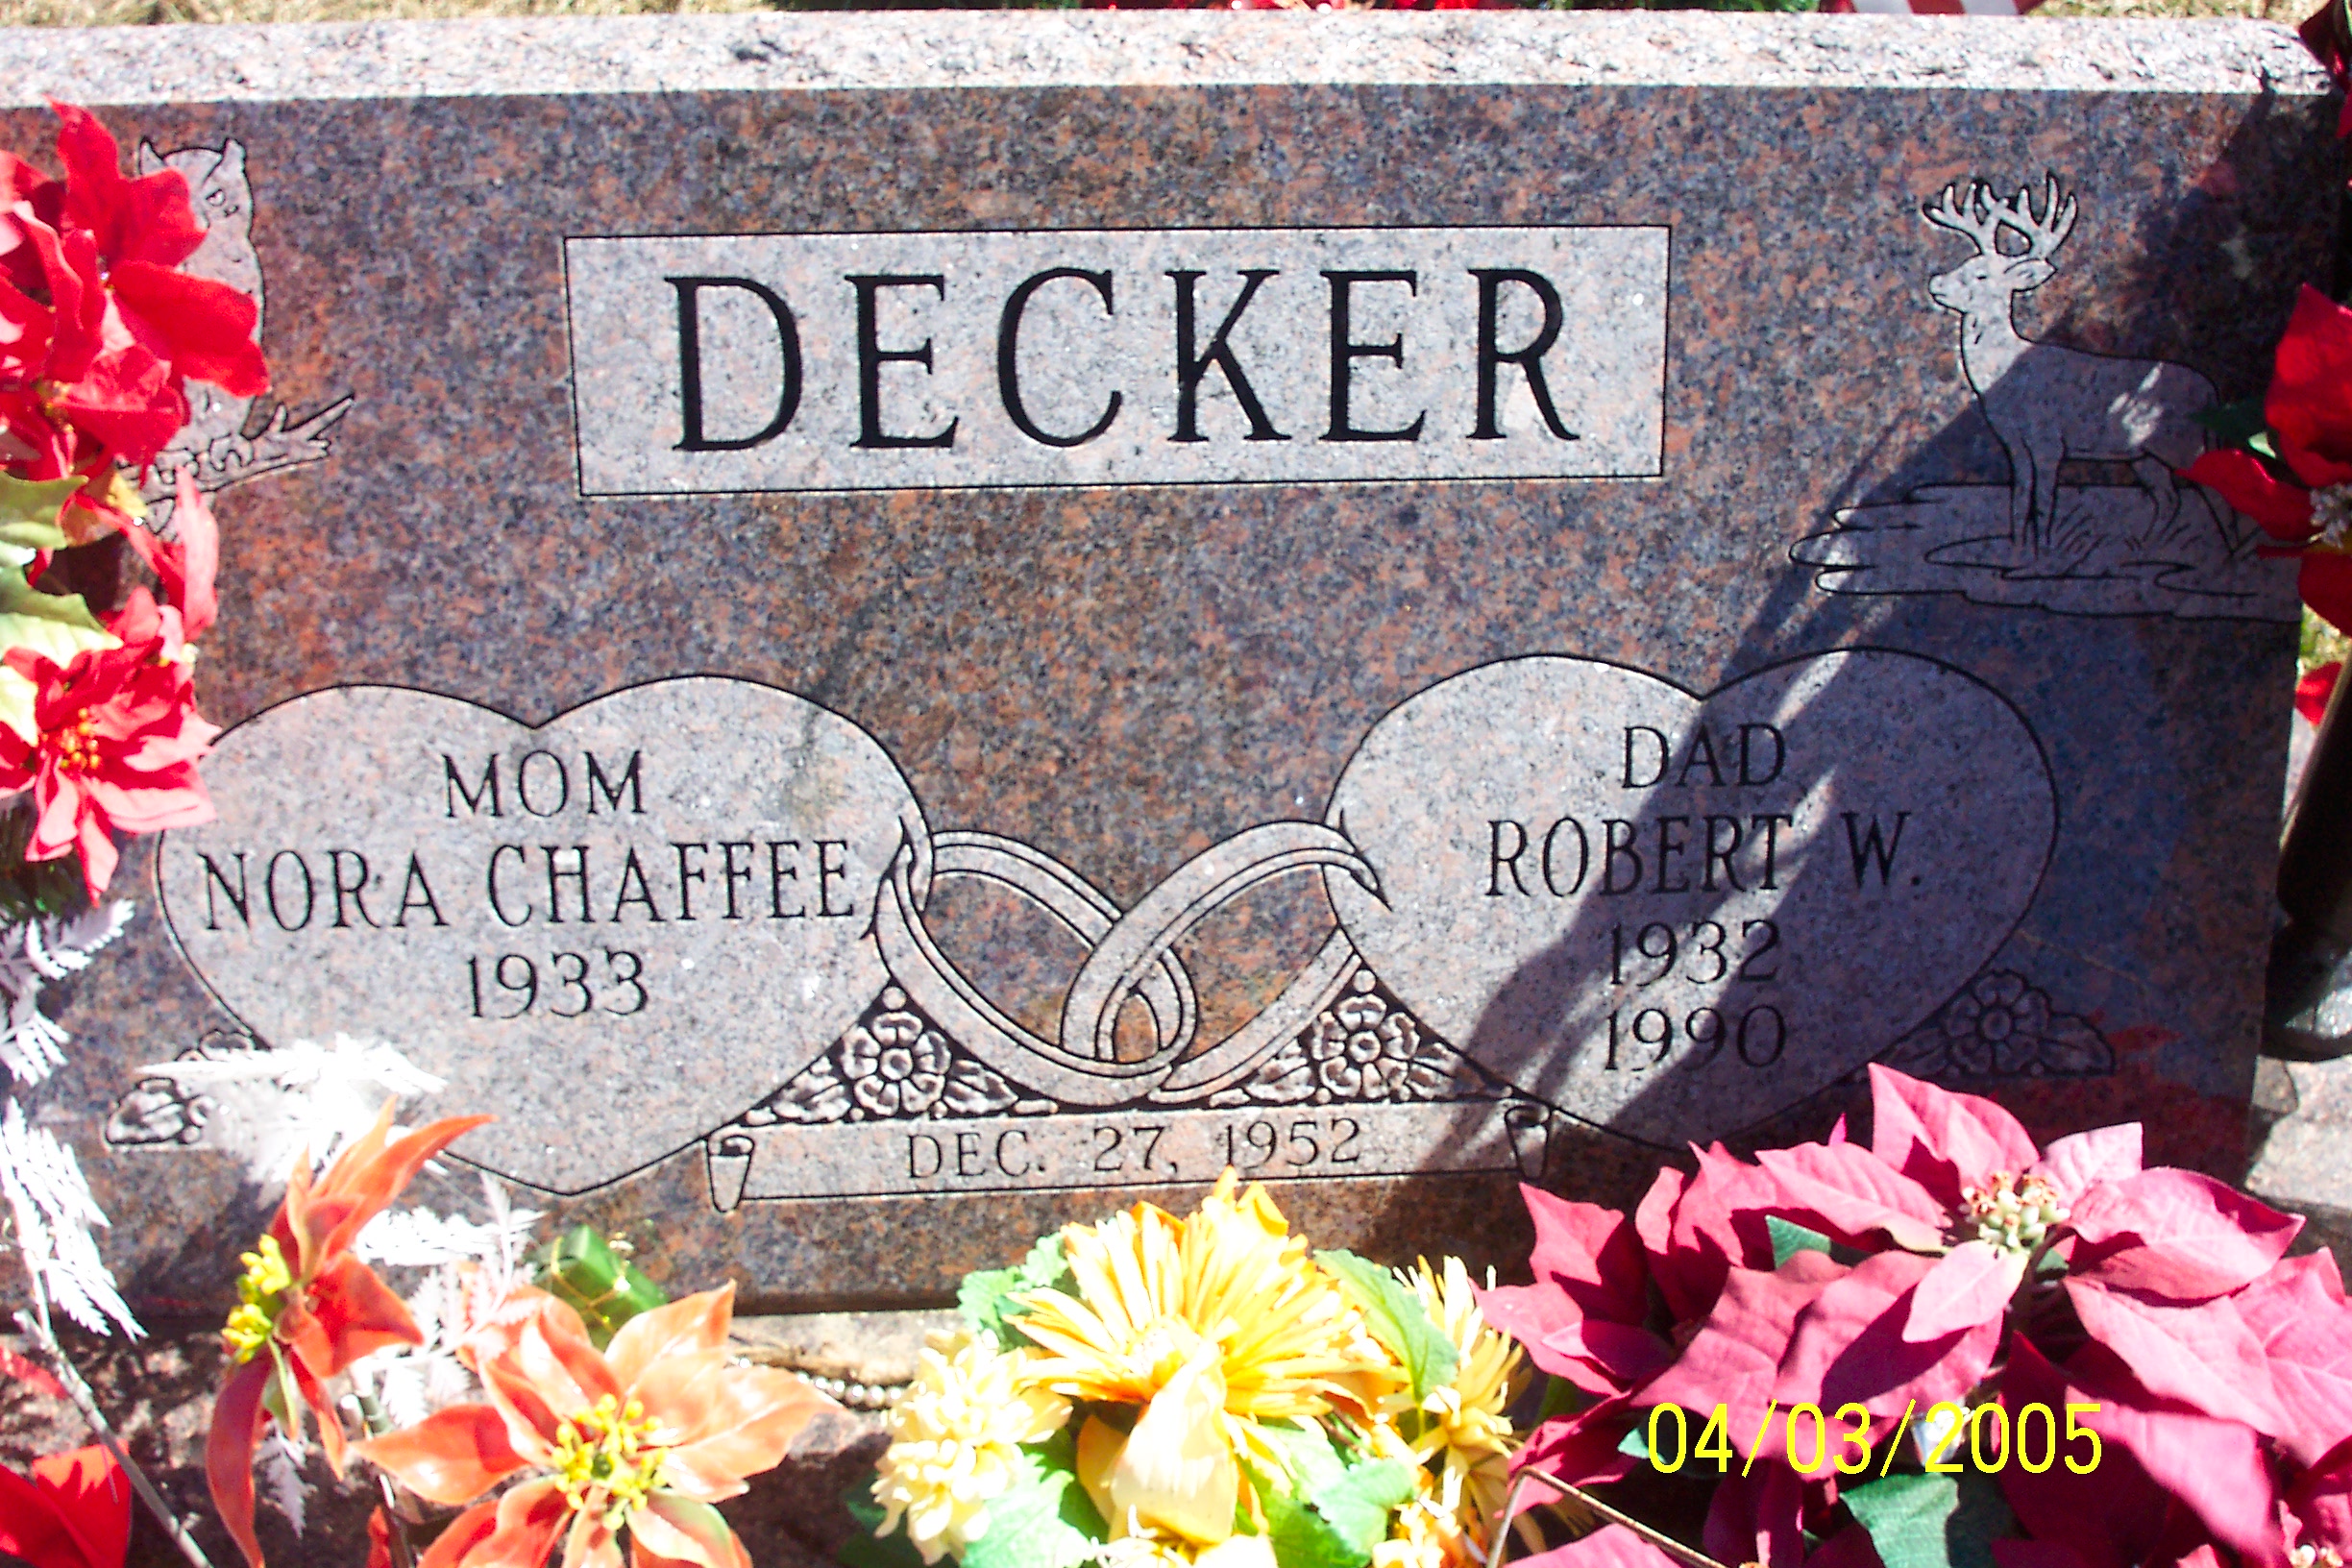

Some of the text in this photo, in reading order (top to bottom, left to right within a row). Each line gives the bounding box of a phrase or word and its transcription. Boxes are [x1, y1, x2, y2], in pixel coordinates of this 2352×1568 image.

[664, 266, 1580, 452] DECKER
[443, 749, 648, 819] MOM
[1622, 723, 1786, 789] DAD
[197, 840, 855, 931] NORA CHAFFEE
[1484, 812, 1921, 897] ROBERT W.
[468, 947, 649, 1018] 1933
[1609, 919, 1780, 986] 1932
[1605, 1005, 1787, 1071] 1990
[908, 1118, 1361, 1179] DEC. 27, 1952
